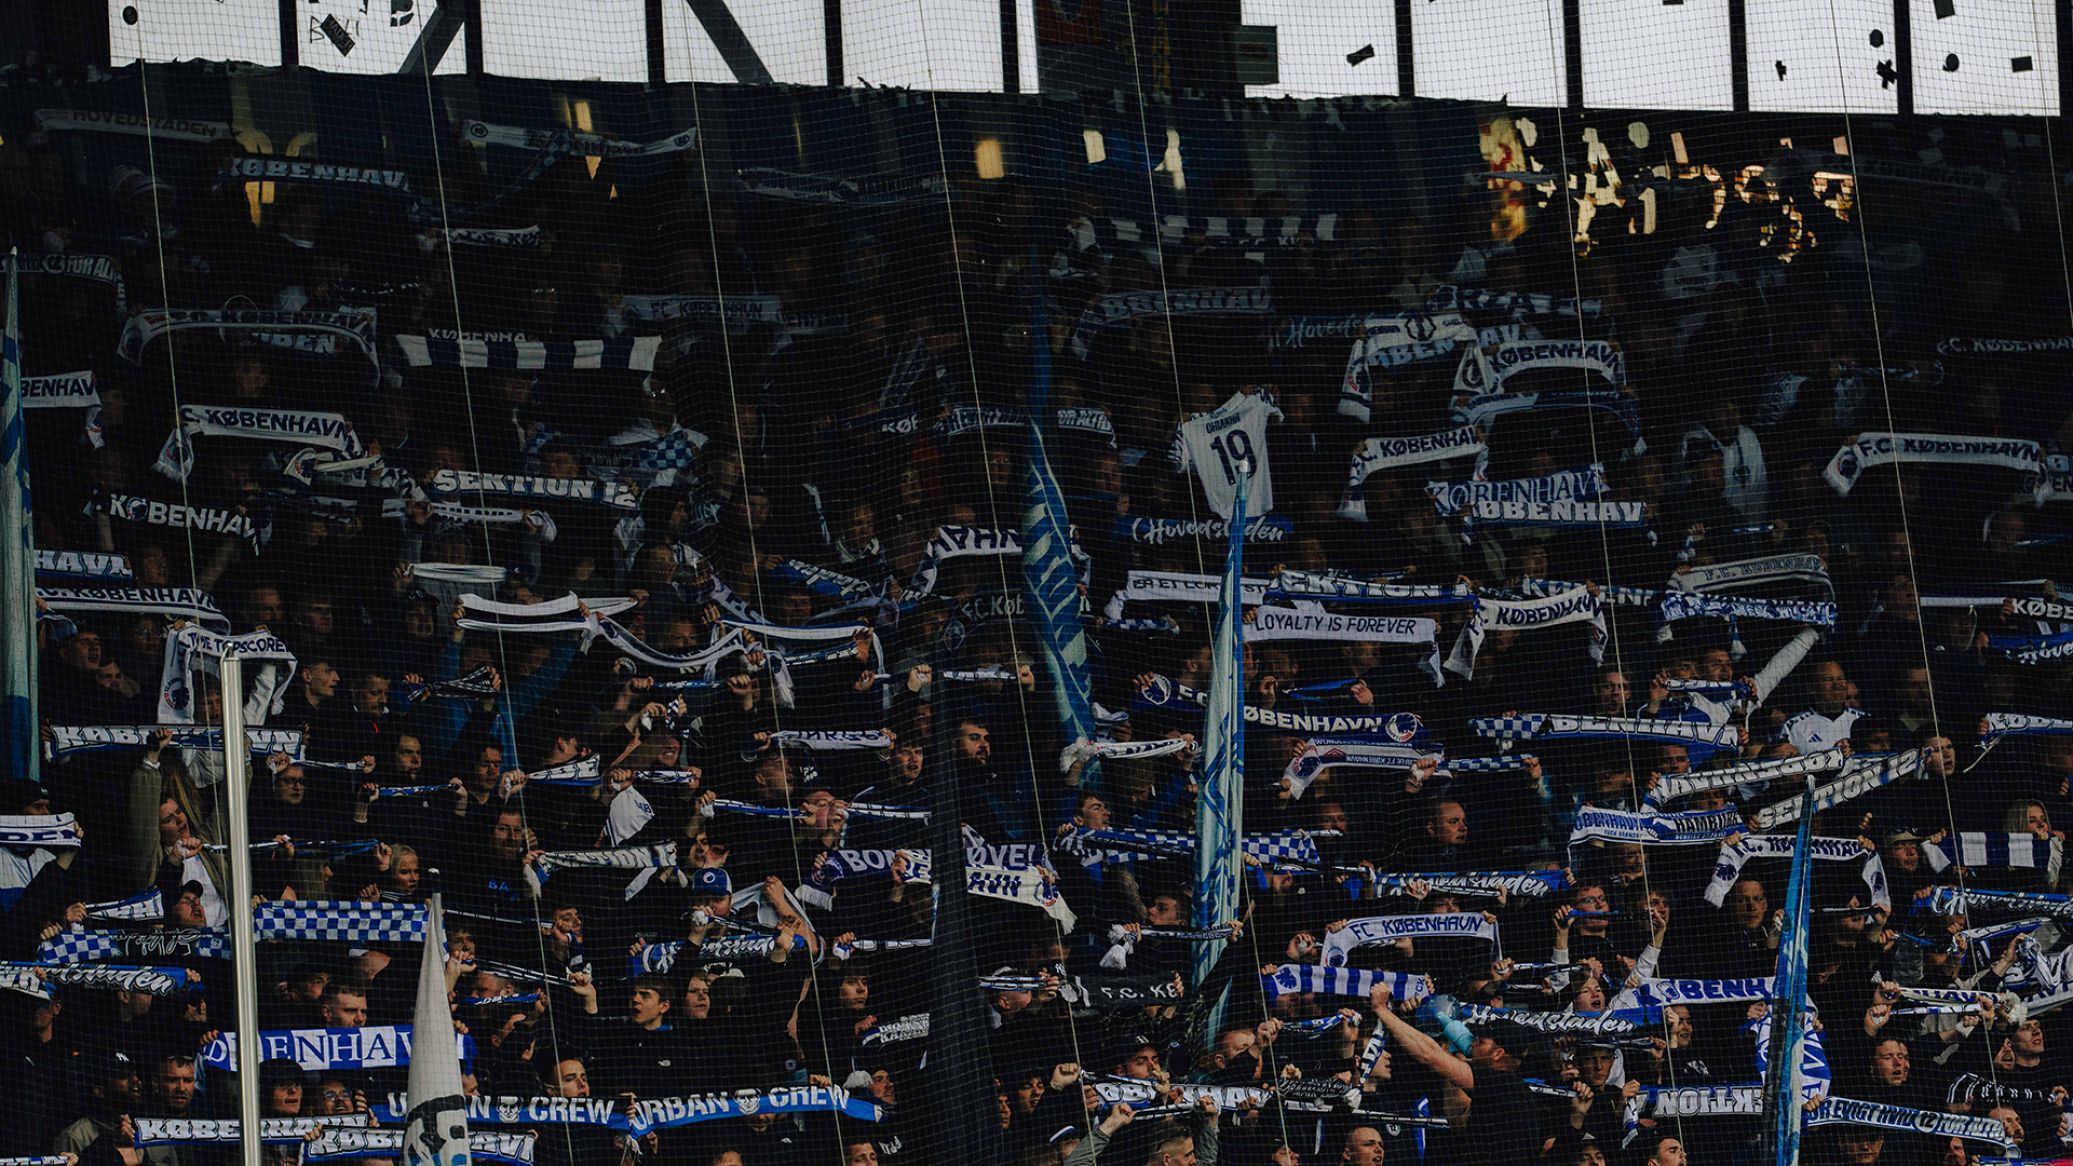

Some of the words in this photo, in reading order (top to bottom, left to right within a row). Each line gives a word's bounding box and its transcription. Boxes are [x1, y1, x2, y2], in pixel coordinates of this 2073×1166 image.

[231, 158, 409, 191] KØBENHAV
[1210, 429, 1256, 486] 19
[433, 469, 594, 501] SEKTION
[1474, 501, 1644, 522] ØBENHAV
[1254, 613, 1322, 632] LOYALTY
[1327, 617, 1342, 632] IS
[1347, 617, 1416, 635] FOREVER
[1756, 764, 1886, 831] SETION
[1350, 924, 1374, 940] FC
[1382, 916, 1484, 935] KØBENHAVN
[1463, 1003, 1633, 1035] Hedstaden
[528, 1097, 615, 1124] CREW
[628, 1091, 730, 1131] URBAN
[767, 1083, 851, 1110] CREW
